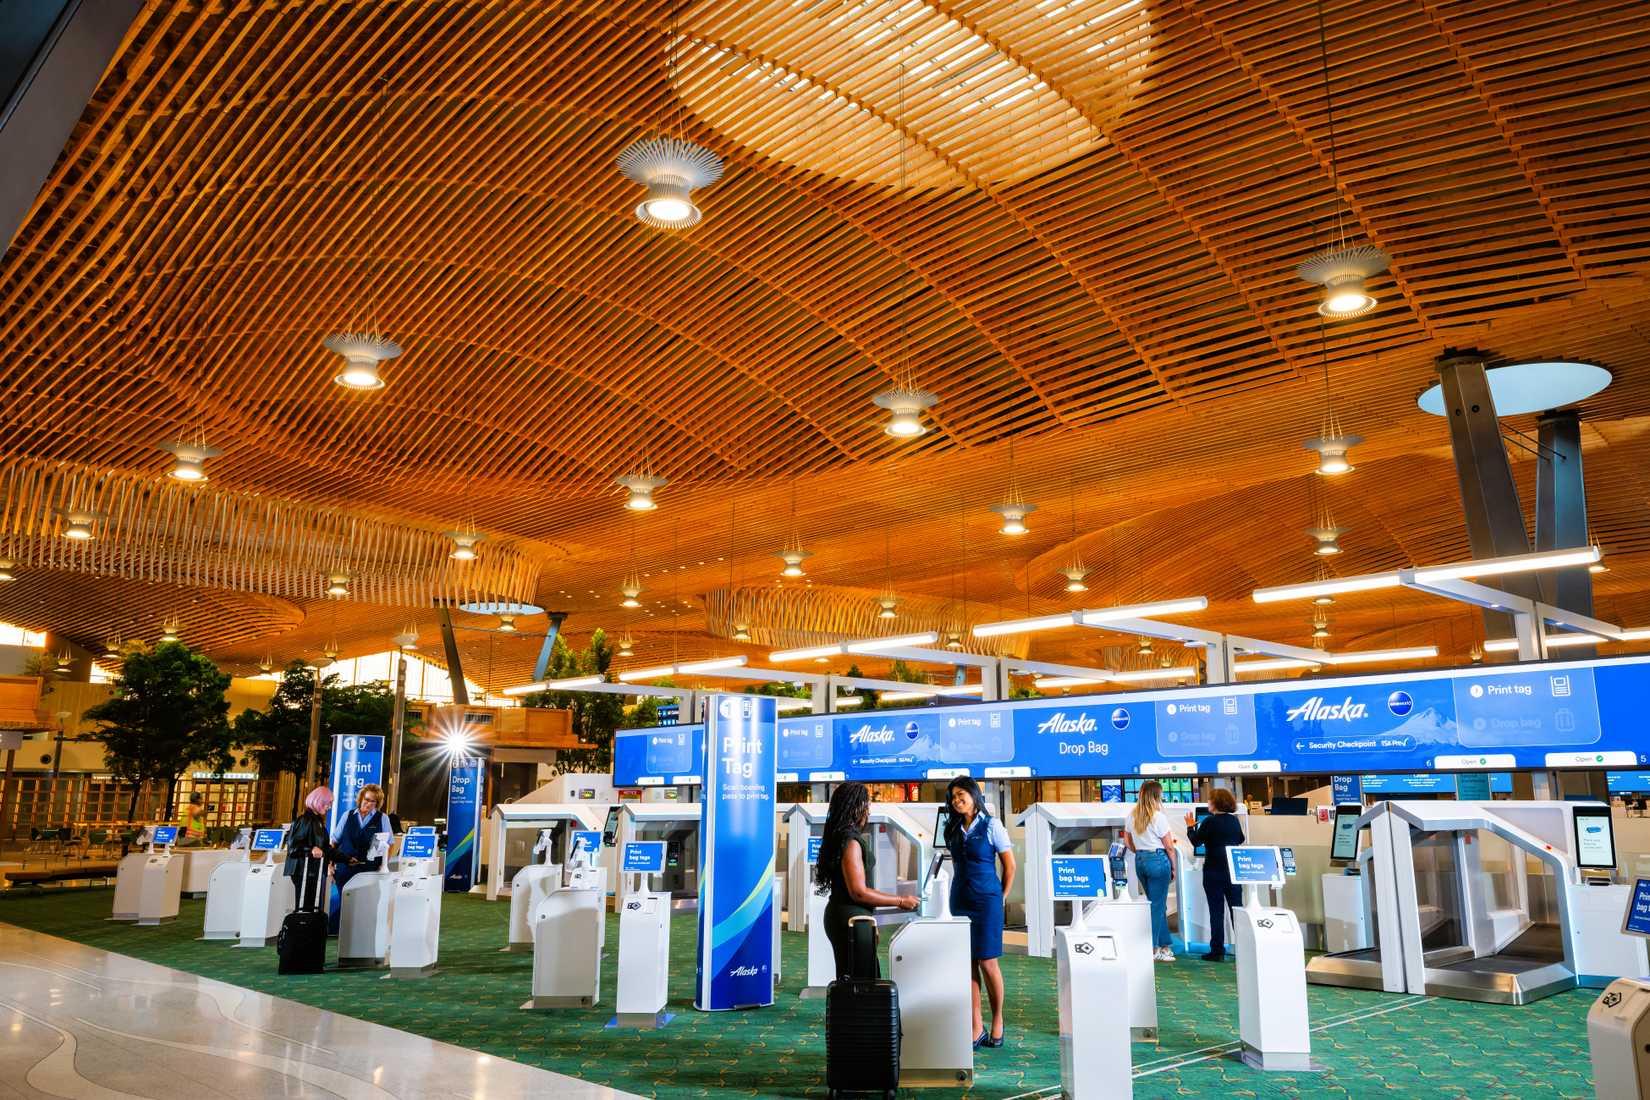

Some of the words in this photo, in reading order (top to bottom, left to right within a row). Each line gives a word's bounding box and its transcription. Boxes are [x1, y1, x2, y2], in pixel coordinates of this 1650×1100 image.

[1487, 685, 1512, 695] Print
[1514, 684, 1532, 695] tag
[1179, 704, 1197, 713] Print
[723, 737, 763, 754] Pint
[1059, 742, 1085, 756] Drop
[1088, 741, 1109, 756] Bag
[1308, 741, 1336, 750] Security
[1337, 740, 1377, 749] Checkpoint
[1640, 755, 1647, 763] 5
[344, 761, 372, 773] Print
[721, 757, 753, 778] Tag
[343, 775, 365, 789] Tag
[452, 776, 470, 785] Drop
[1334, 775, 1352, 785] Drop
[451, 785, 465, 794] Bag
[1334, 784, 1349, 792] Bag
